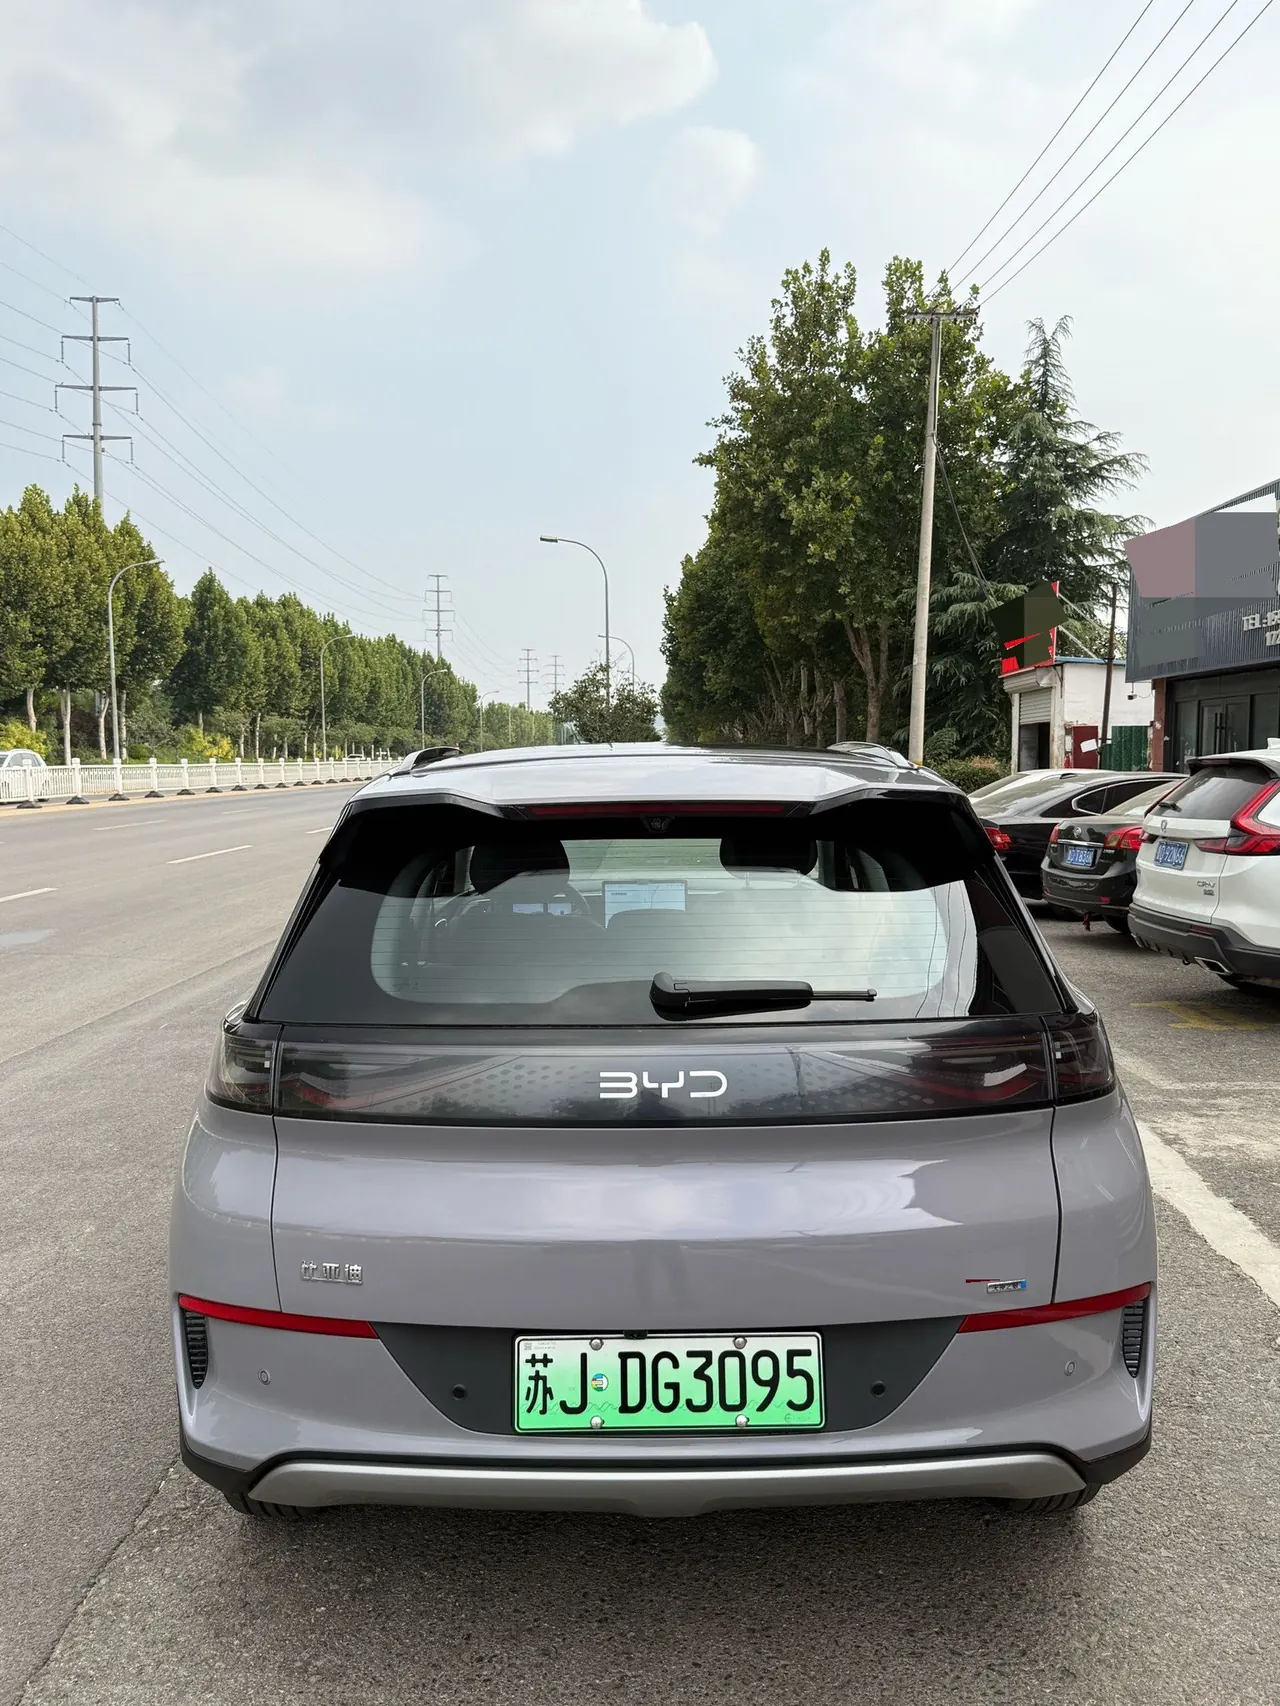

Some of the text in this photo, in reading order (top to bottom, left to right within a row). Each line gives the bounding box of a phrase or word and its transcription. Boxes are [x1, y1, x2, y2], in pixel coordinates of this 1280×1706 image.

[599, 1070, 728, 1098] BYD
[301, 1260, 363, 1285] 比亚迪
